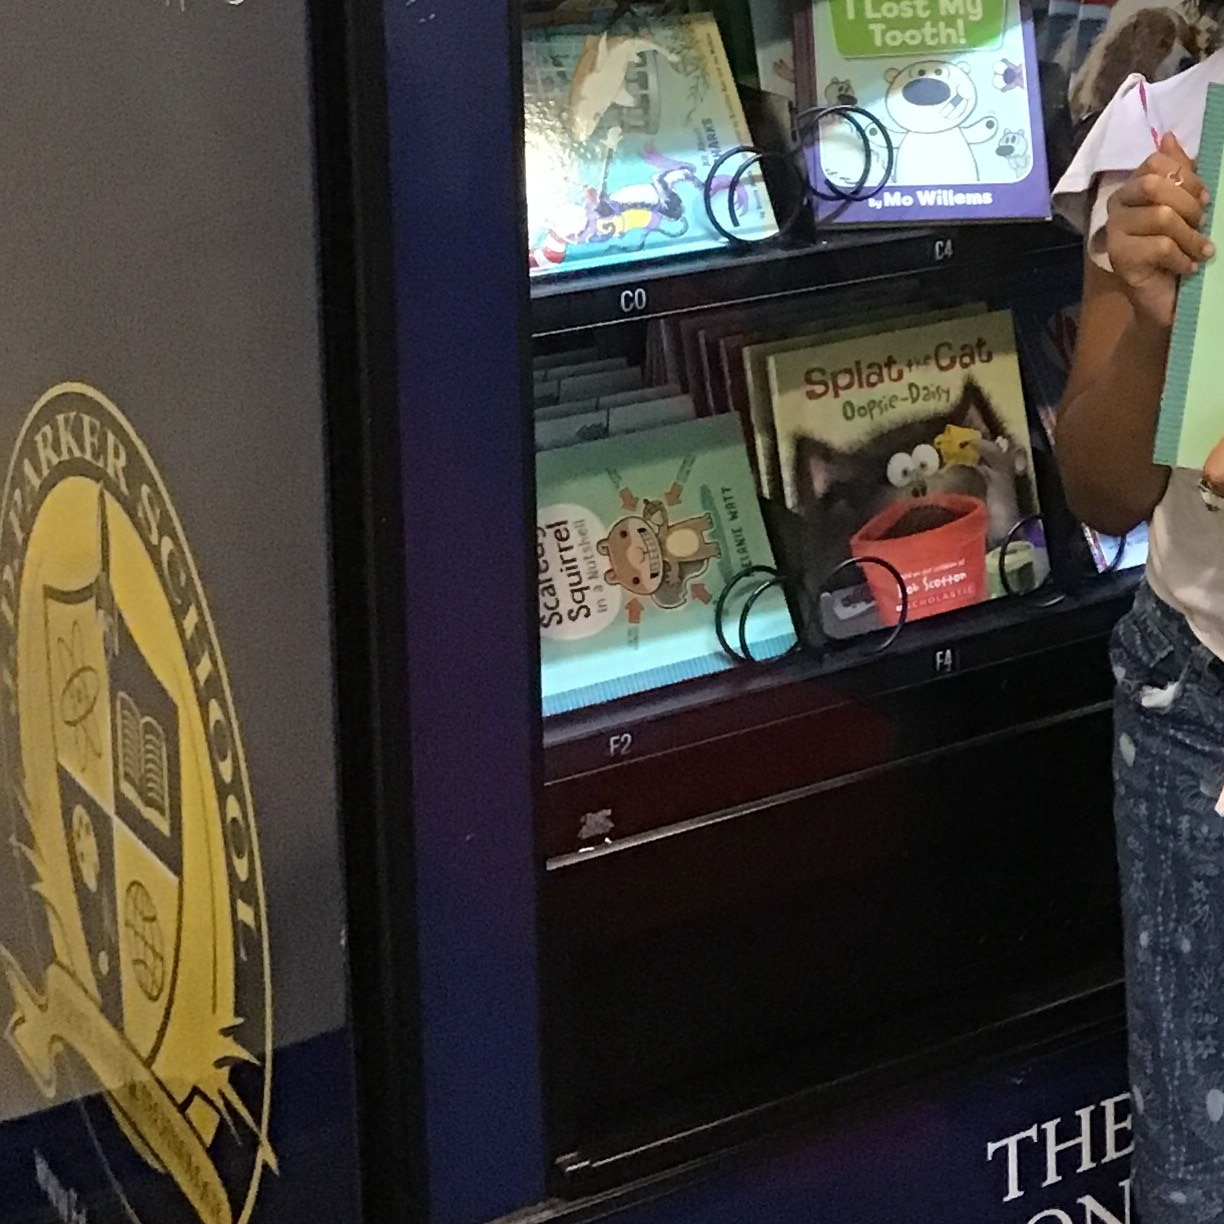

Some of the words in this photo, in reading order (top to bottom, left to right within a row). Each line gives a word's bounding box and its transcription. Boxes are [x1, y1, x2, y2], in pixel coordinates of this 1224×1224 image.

[869, 20, 967, 48] Tooth!
[883, 188, 913, 207] Mo
[916, 188, 994, 207] Willems
[935, 239, 954, 261] C4
[803, 354, 905, 401] Splat
[934, 336, 994, 373] Cat
[842, 381, 952, 422] Oopsie-Daisy
[720, 487, 739, 521] WATT
[544, 519, 591, 622] Squirrel
[731, 527, 755, 577] ELANIE
[935, 649, 953, 672] F4
[137, 484, 259, 960] SCHOOL
[609, 732, 633, 756] F2
[986, 1091, 1134, 1203] THE
